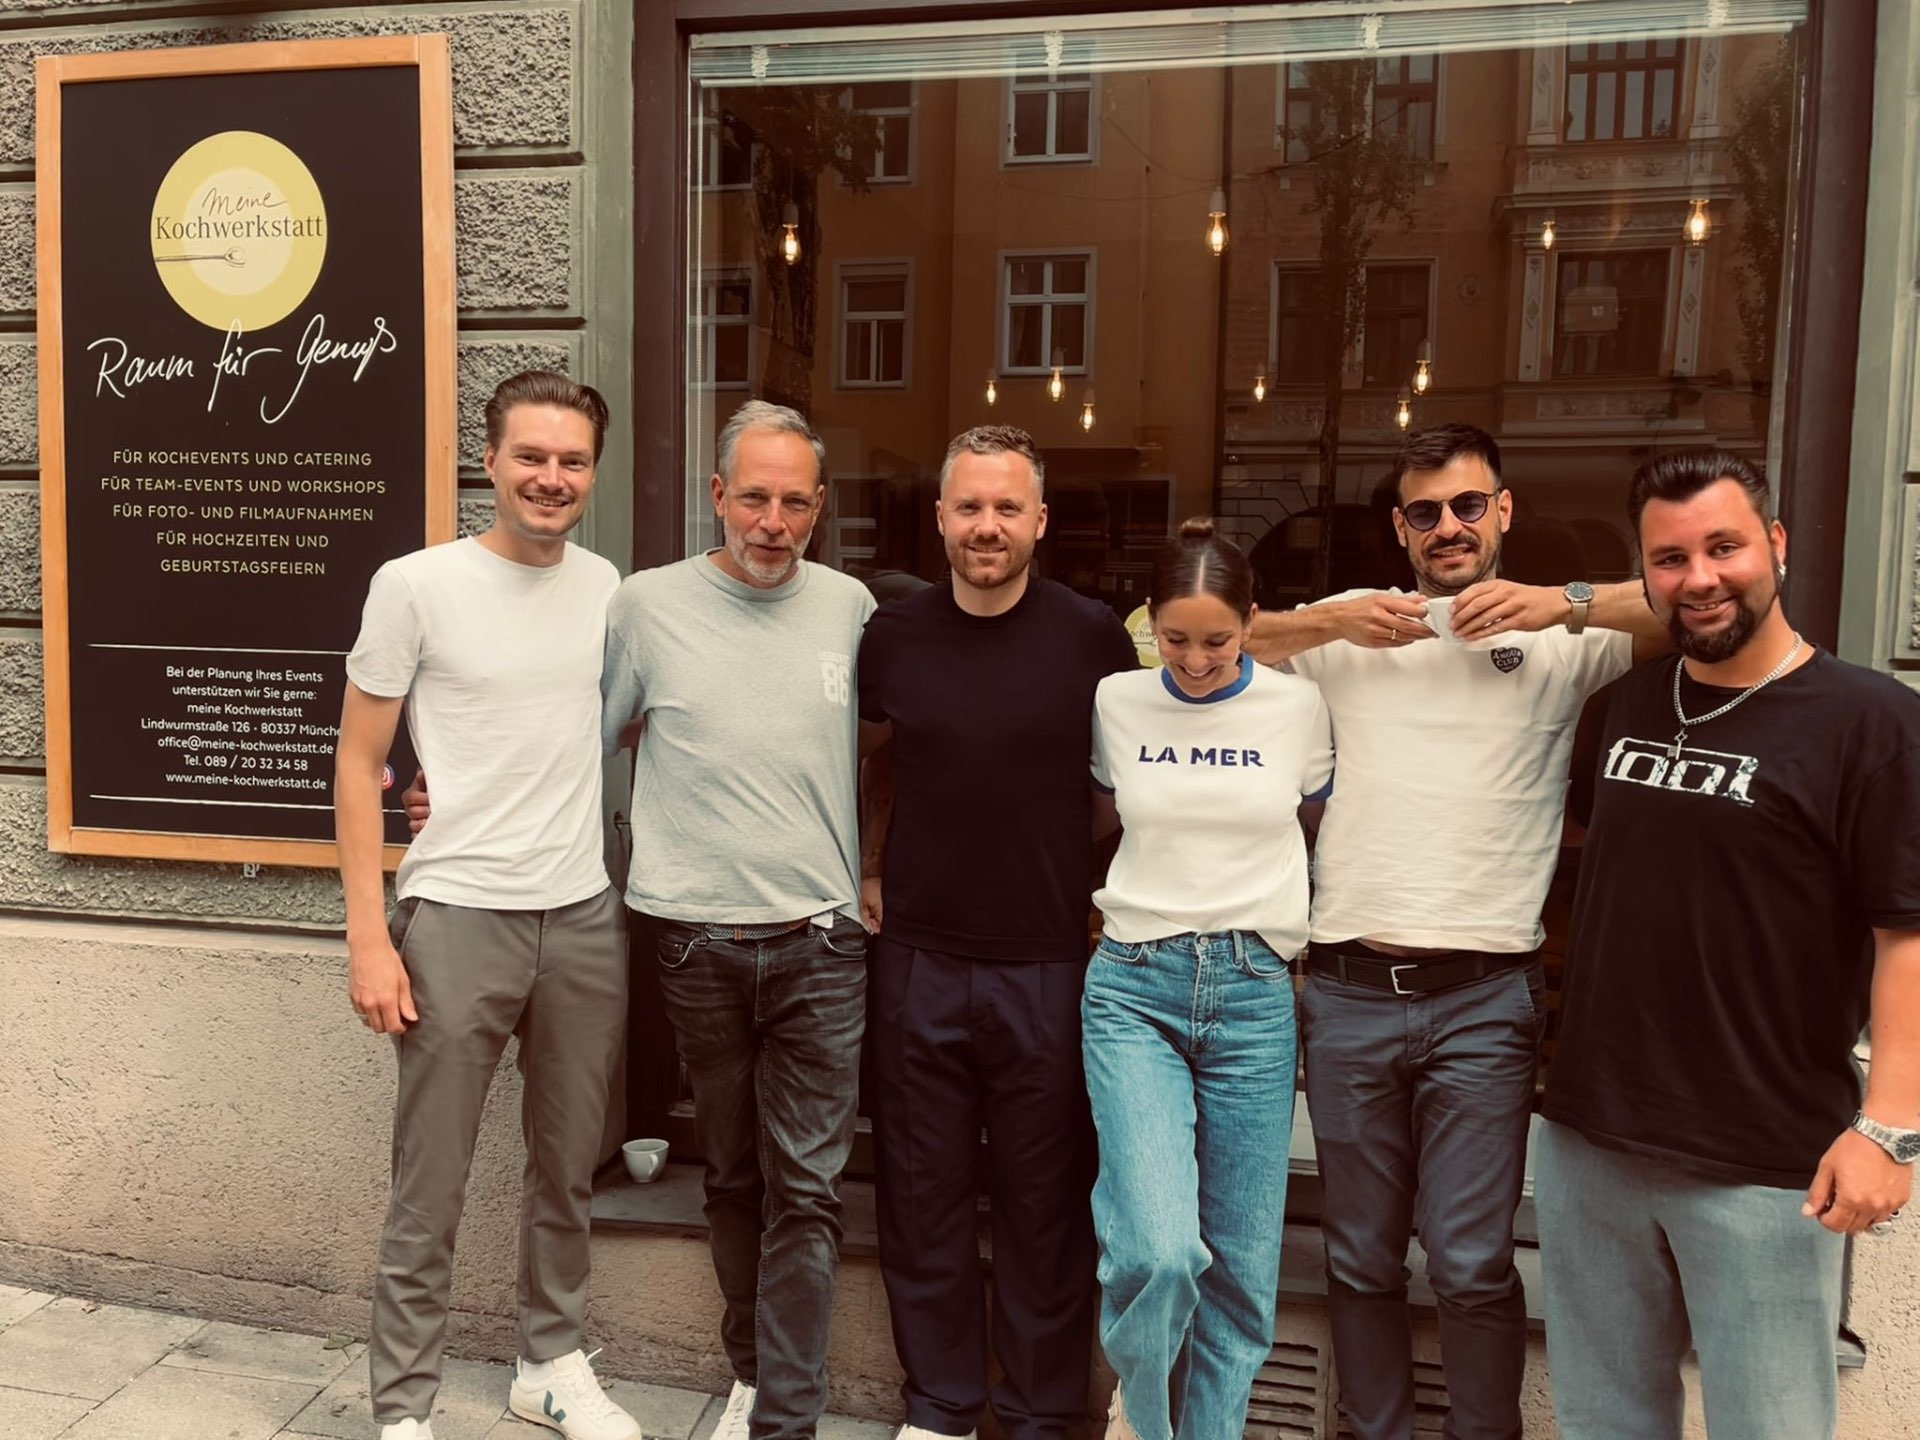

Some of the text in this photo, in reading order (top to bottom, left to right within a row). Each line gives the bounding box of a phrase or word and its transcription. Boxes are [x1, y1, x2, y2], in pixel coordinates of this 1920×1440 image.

[200, 187, 287, 216] meine
[155, 215, 323, 240] Kochwerkstatt
[87, 337, 194, 398] Raum
[207, 317, 283, 412] für
[113, 449, 371, 465] FÜR KOCHEVENTS UND CATERING
[101, 476, 385, 493] FÜR TEAM-EVENTS UND WORKSHOPS
[113, 503, 372, 520] FÜR FOTO- UND FILMAUFNAHMEN
[156, 531, 328, 547] FÜR HOCHZEITEN UND
[160, 560, 324, 574] GEBURTSTAGSFEIERN
[1496, 657, 1520, 667] CLUB
[166, 666, 323, 682] Bei der Planung Ihres Events
[821, 661, 849, 707] 86
[172, 686, 316, 701] unterstützen wir Sie gerne:
[187, 703, 302, 717] meine Kochwerkstatt
[141, 718, 229, 732] Lindwurmstraße
[231, 722, 250, 732] 126
[260, 723, 296, 734] 80337
[157, 735, 334, 755] office@meine-kochwerkstatt.de
[183, 755, 201, 765] Tel.
[204, 756, 227, 767] 089
[241, 757, 256, 768] 20
[259, 758, 272, 769] 32
[276, 759, 290, 769] 34
[293, 759, 308, 770] 58
[1138, 745, 1265, 767] LA MER
[166, 774, 326, 789] www.meine-kochwerkstatt.de
